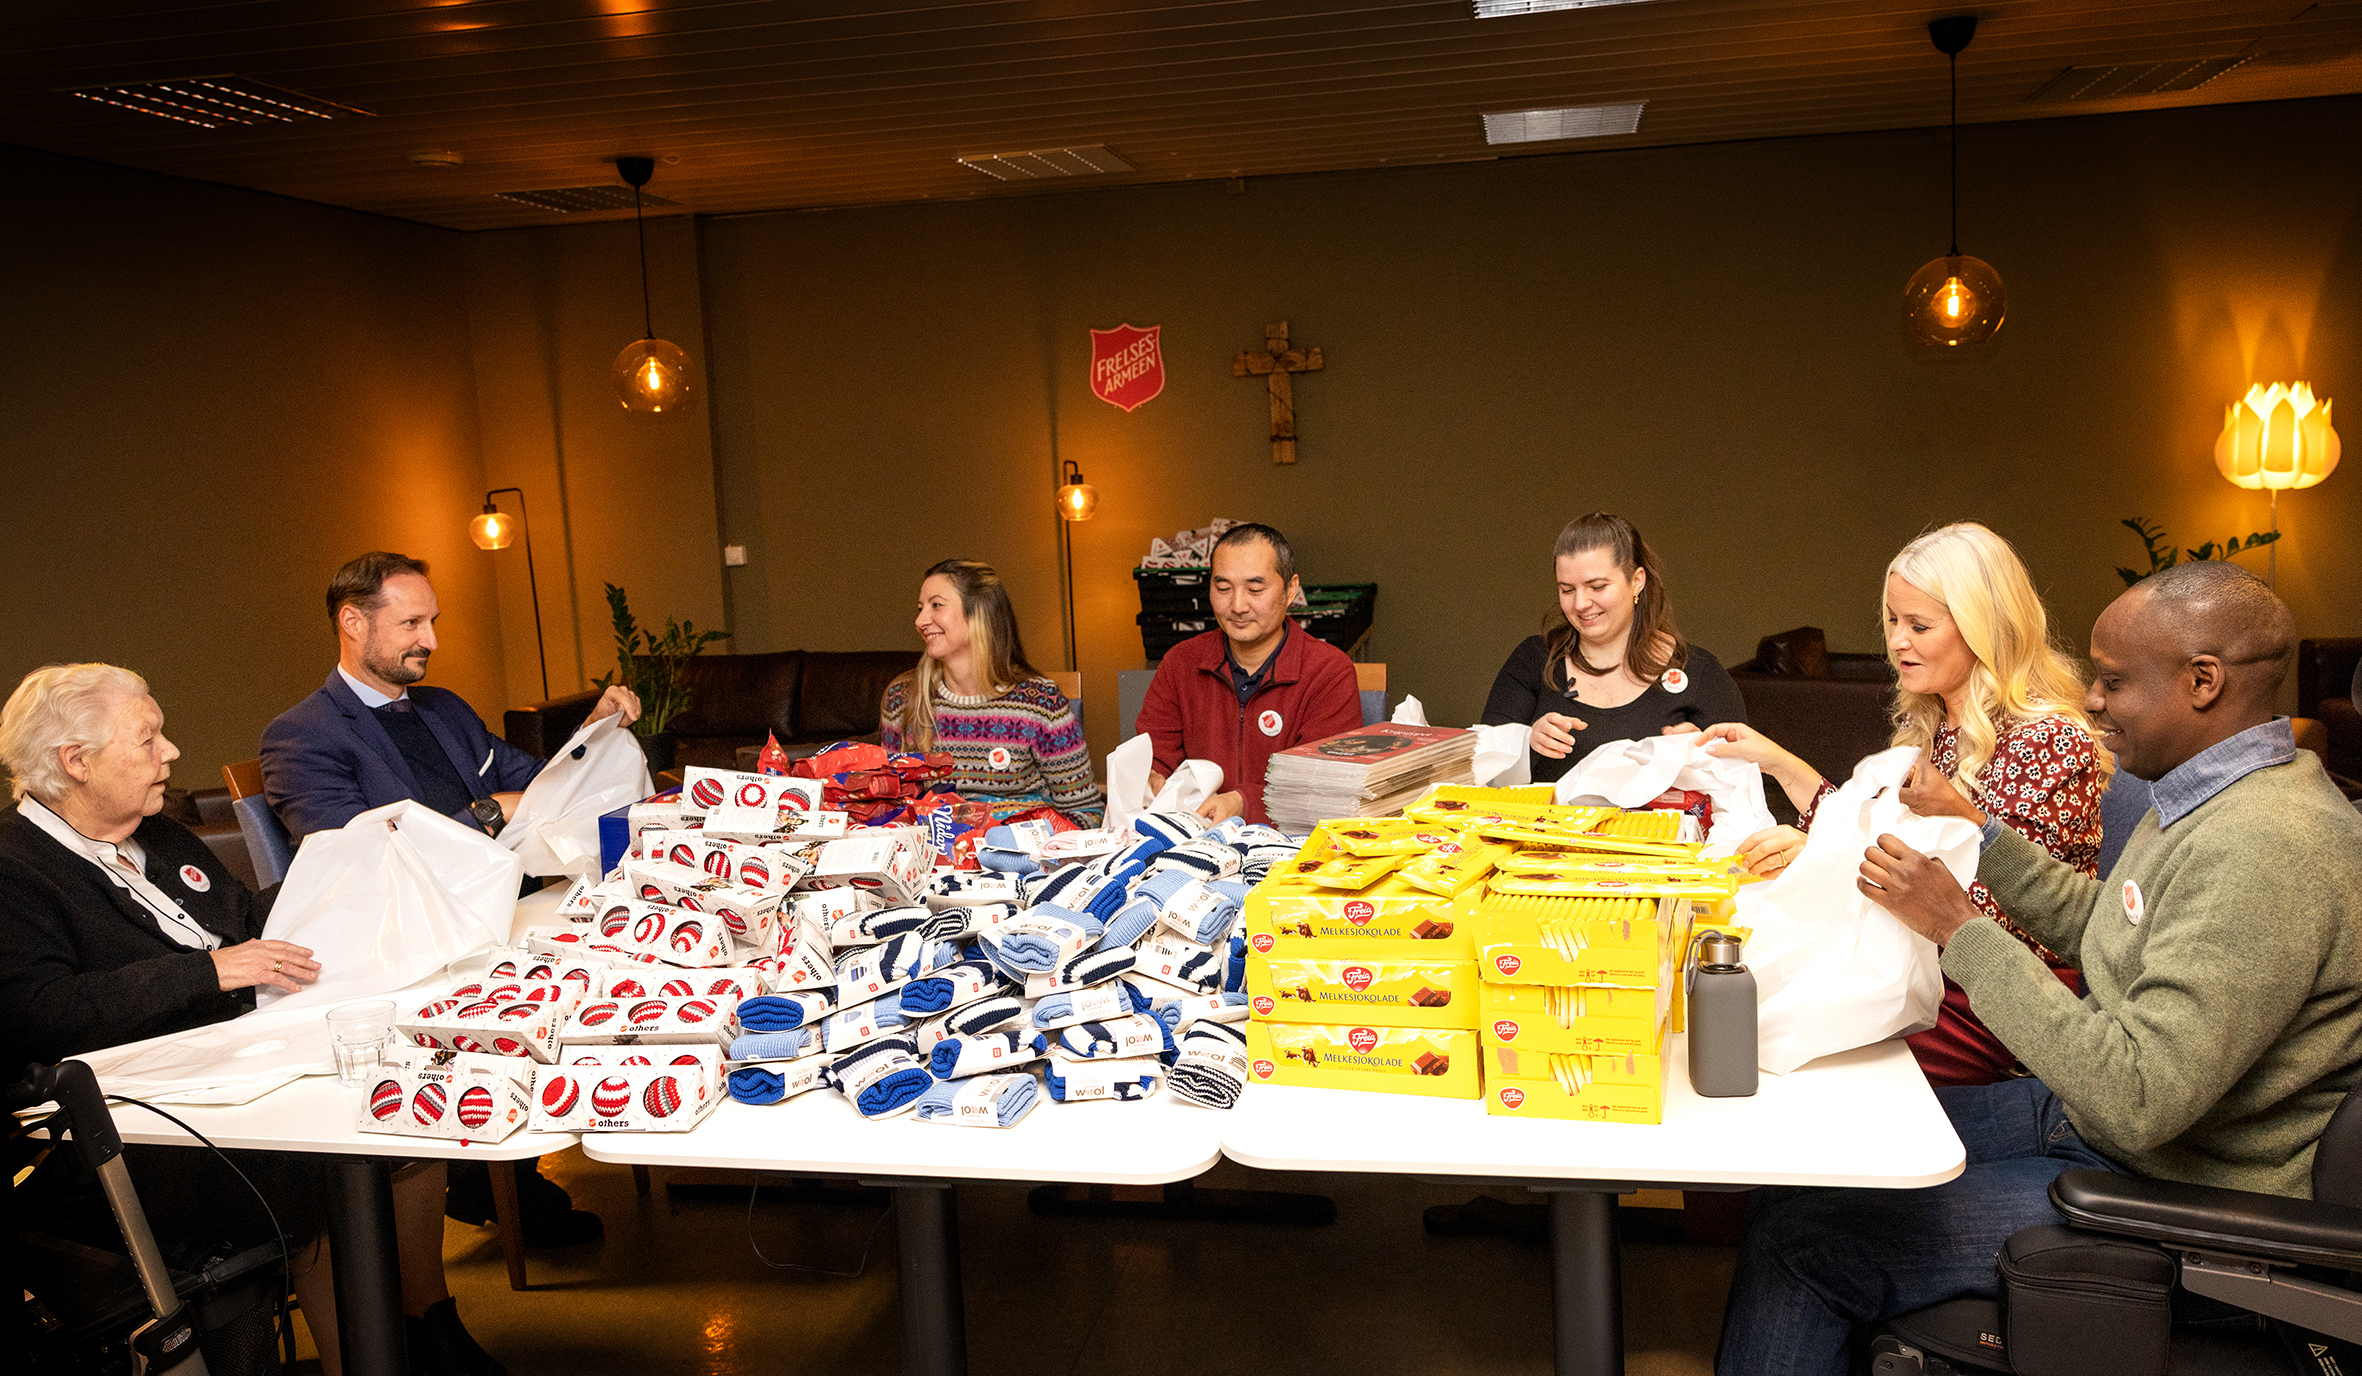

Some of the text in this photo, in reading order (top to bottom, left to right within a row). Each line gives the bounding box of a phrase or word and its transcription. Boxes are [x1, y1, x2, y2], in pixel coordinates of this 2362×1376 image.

[1104, 351, 1155, 396] ARMEEN
[736, 774, 763, 782] others
[931, 804, 955, 856] Nidar
[704, 840, 728, 850] others
[1084, 837, 1108, 848] wool
[782, 861, 801, 874] others
[566, 885, 585, 908] others
[673, 886, 698, 897] others
[647, 904, 670, 914] others
[1348, 904, 1373, 919] Freia
[822, 904, 830, 932] others
[1168, 910, 1191, 928] wool
[1020, 923, 1053, 932] wool
[1320, 926, 1402, 937] MELKESJOKOLADE
[717, 932, 728, 957] others
[532, 955, 556, 964] others
[802, 955, 822, 981] others
[1346, 970, 1371, 985] Freia
[1319, 991, 1400, 1004] MELKESJOKOLADE
[547, 1017, 557, 1050] others
[628, 1024, 660, 1032] others
[1126, 1034, 1153, 1047] wool
[1352, 1032, 1377, 1048] Freia
[1188, 1050, 1226, 1062] wool
[1324, 1052, 1403, 1068] MELKESJOKOLADE
[418, 1072, 445, 1082] others
[792, 1074, 813, 1090] wool
[854, 1063, 890, 1088] wool
[1075, 1086, 1105, 1096] wool
[510, 1092, 530, 1112] others
[694, 1098, 710, 1116] others
[961, 1105, 988, 1116] wool
[598, 1119, 629, 1128] others
